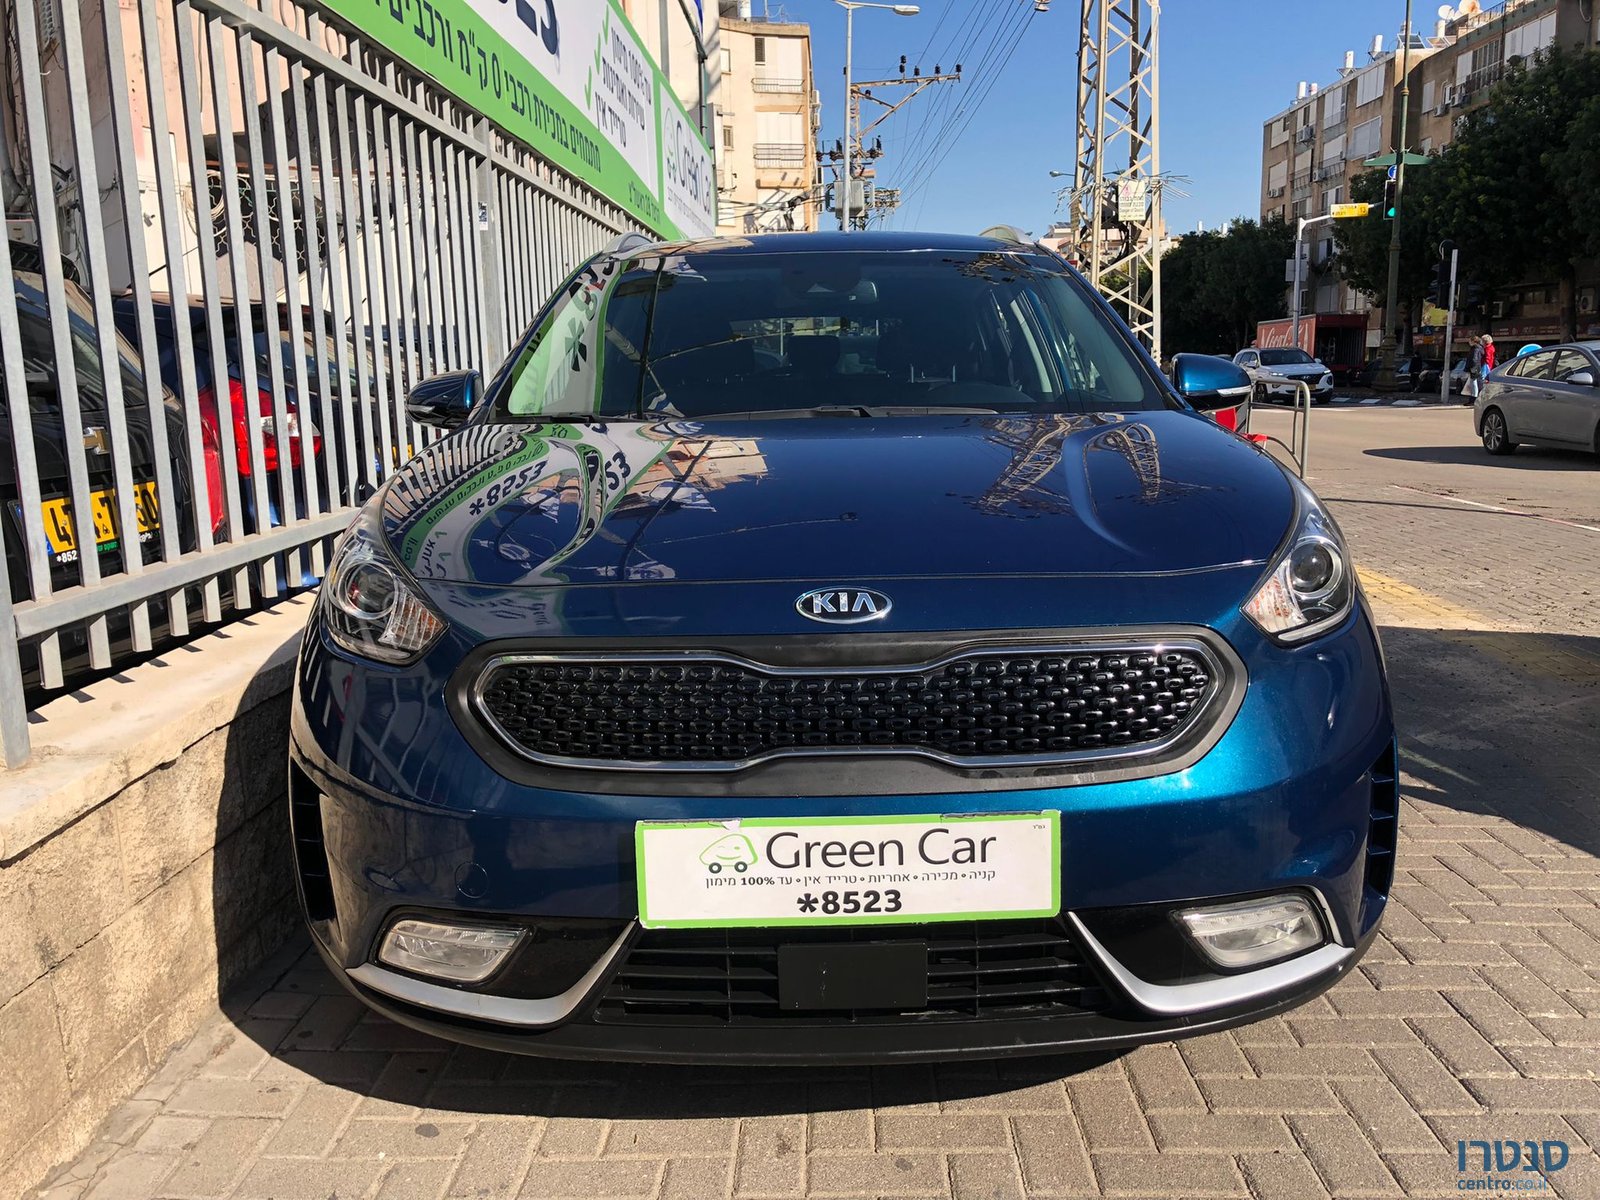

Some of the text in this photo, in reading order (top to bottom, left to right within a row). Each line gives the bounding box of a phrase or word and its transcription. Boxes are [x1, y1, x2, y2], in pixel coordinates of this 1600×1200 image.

[504, 70, 532, 122] רכבי
[533, 93, 569, 149] במכירת
[812, 592, 877, 613] KIA
[765, 828, 997, 869] Green Car
[705, 869, 996, 889] קניה מכירה אחריות טרייד אין עד 100% מימון
